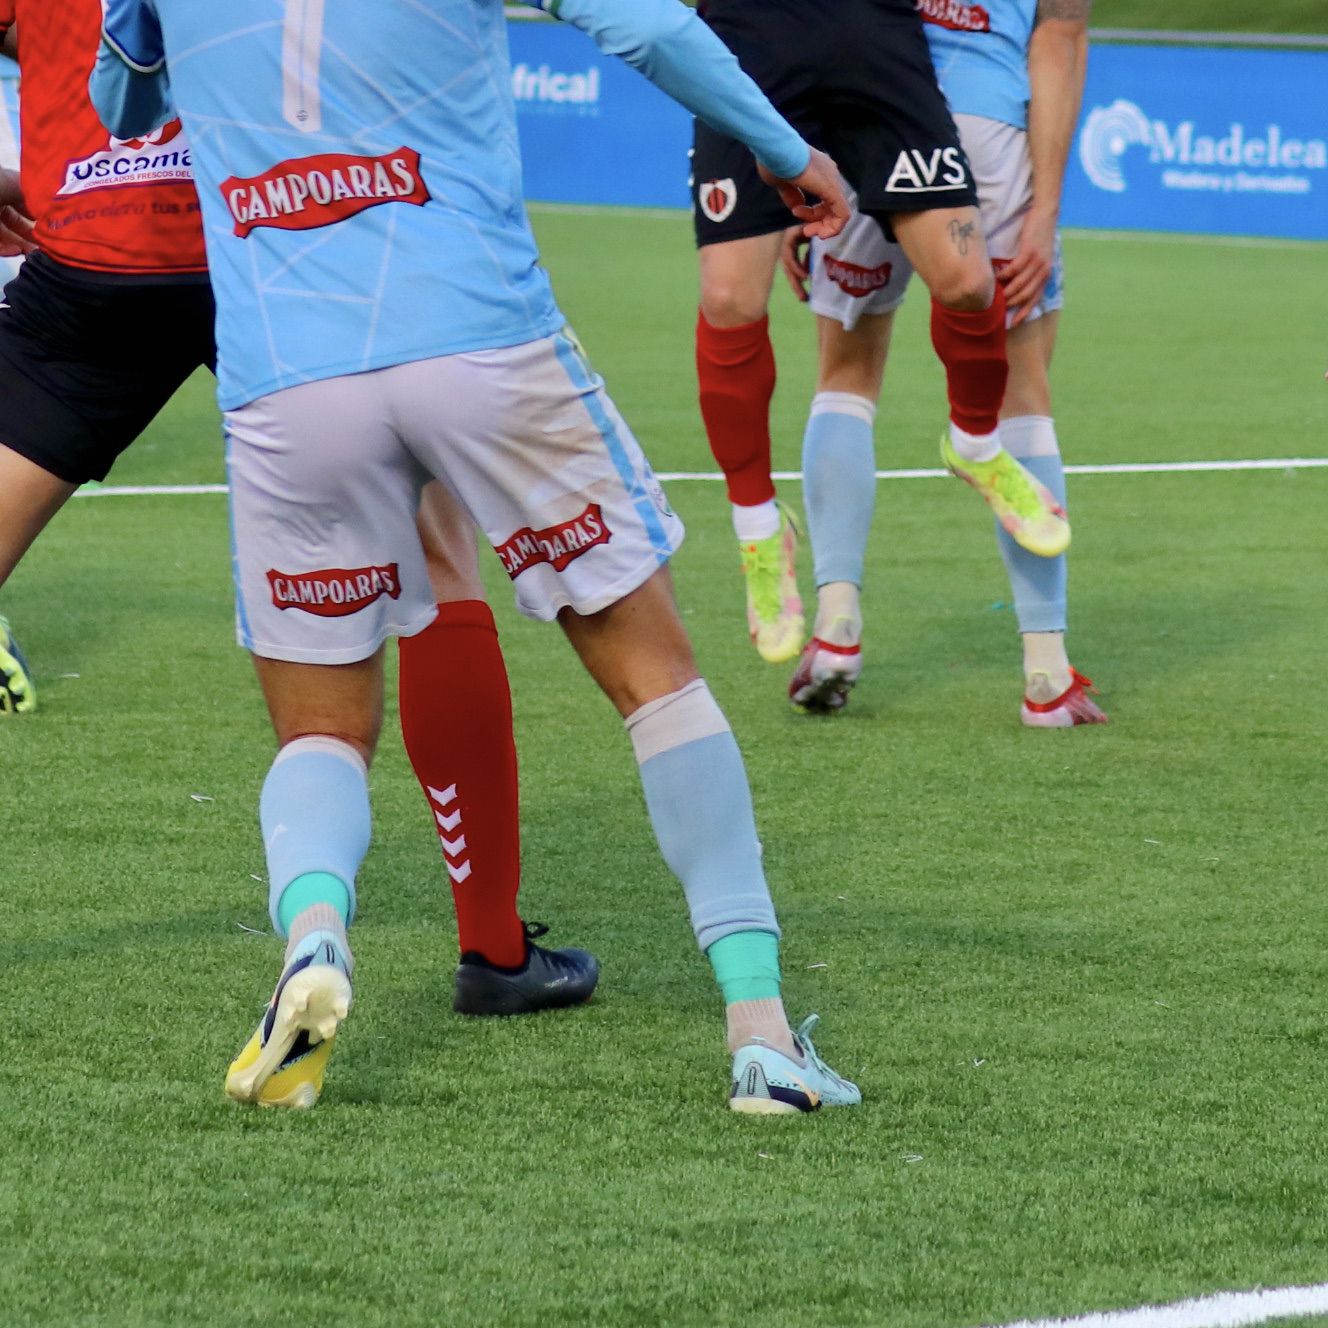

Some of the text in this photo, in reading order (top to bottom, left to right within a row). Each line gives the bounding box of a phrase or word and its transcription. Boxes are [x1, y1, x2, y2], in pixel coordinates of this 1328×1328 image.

[885, 146, 965, 190] AVS
[228, 158, 416, 224] CAMPOARAS
[273, 568, 395, 605] CAMPOARAS
